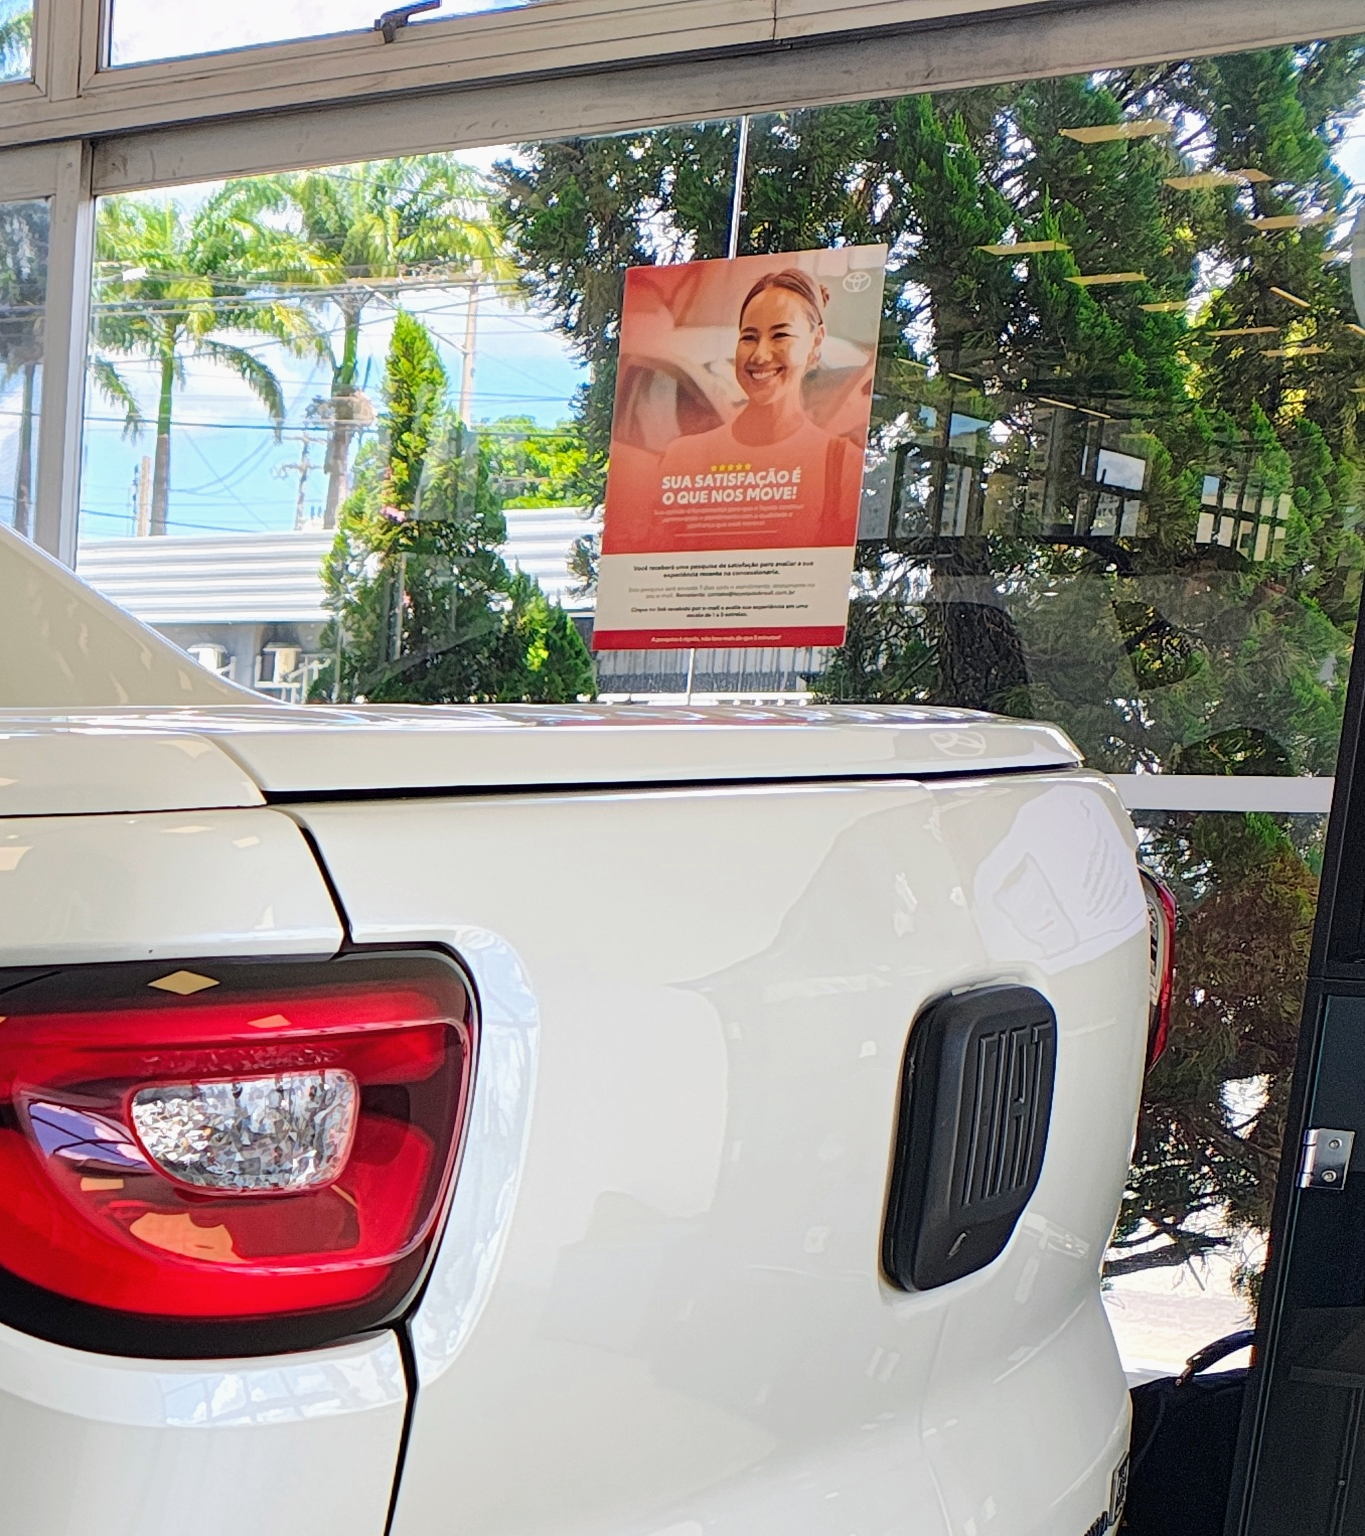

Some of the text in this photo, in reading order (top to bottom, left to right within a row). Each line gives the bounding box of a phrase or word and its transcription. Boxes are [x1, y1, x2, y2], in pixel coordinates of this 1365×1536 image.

[661, 466, 802, 490] SUA SATISFAÇÃO É
[662, 486, 797, 506] O QUE NOS MOVE!
[961, 1020, 1053, 1208] FIAT
